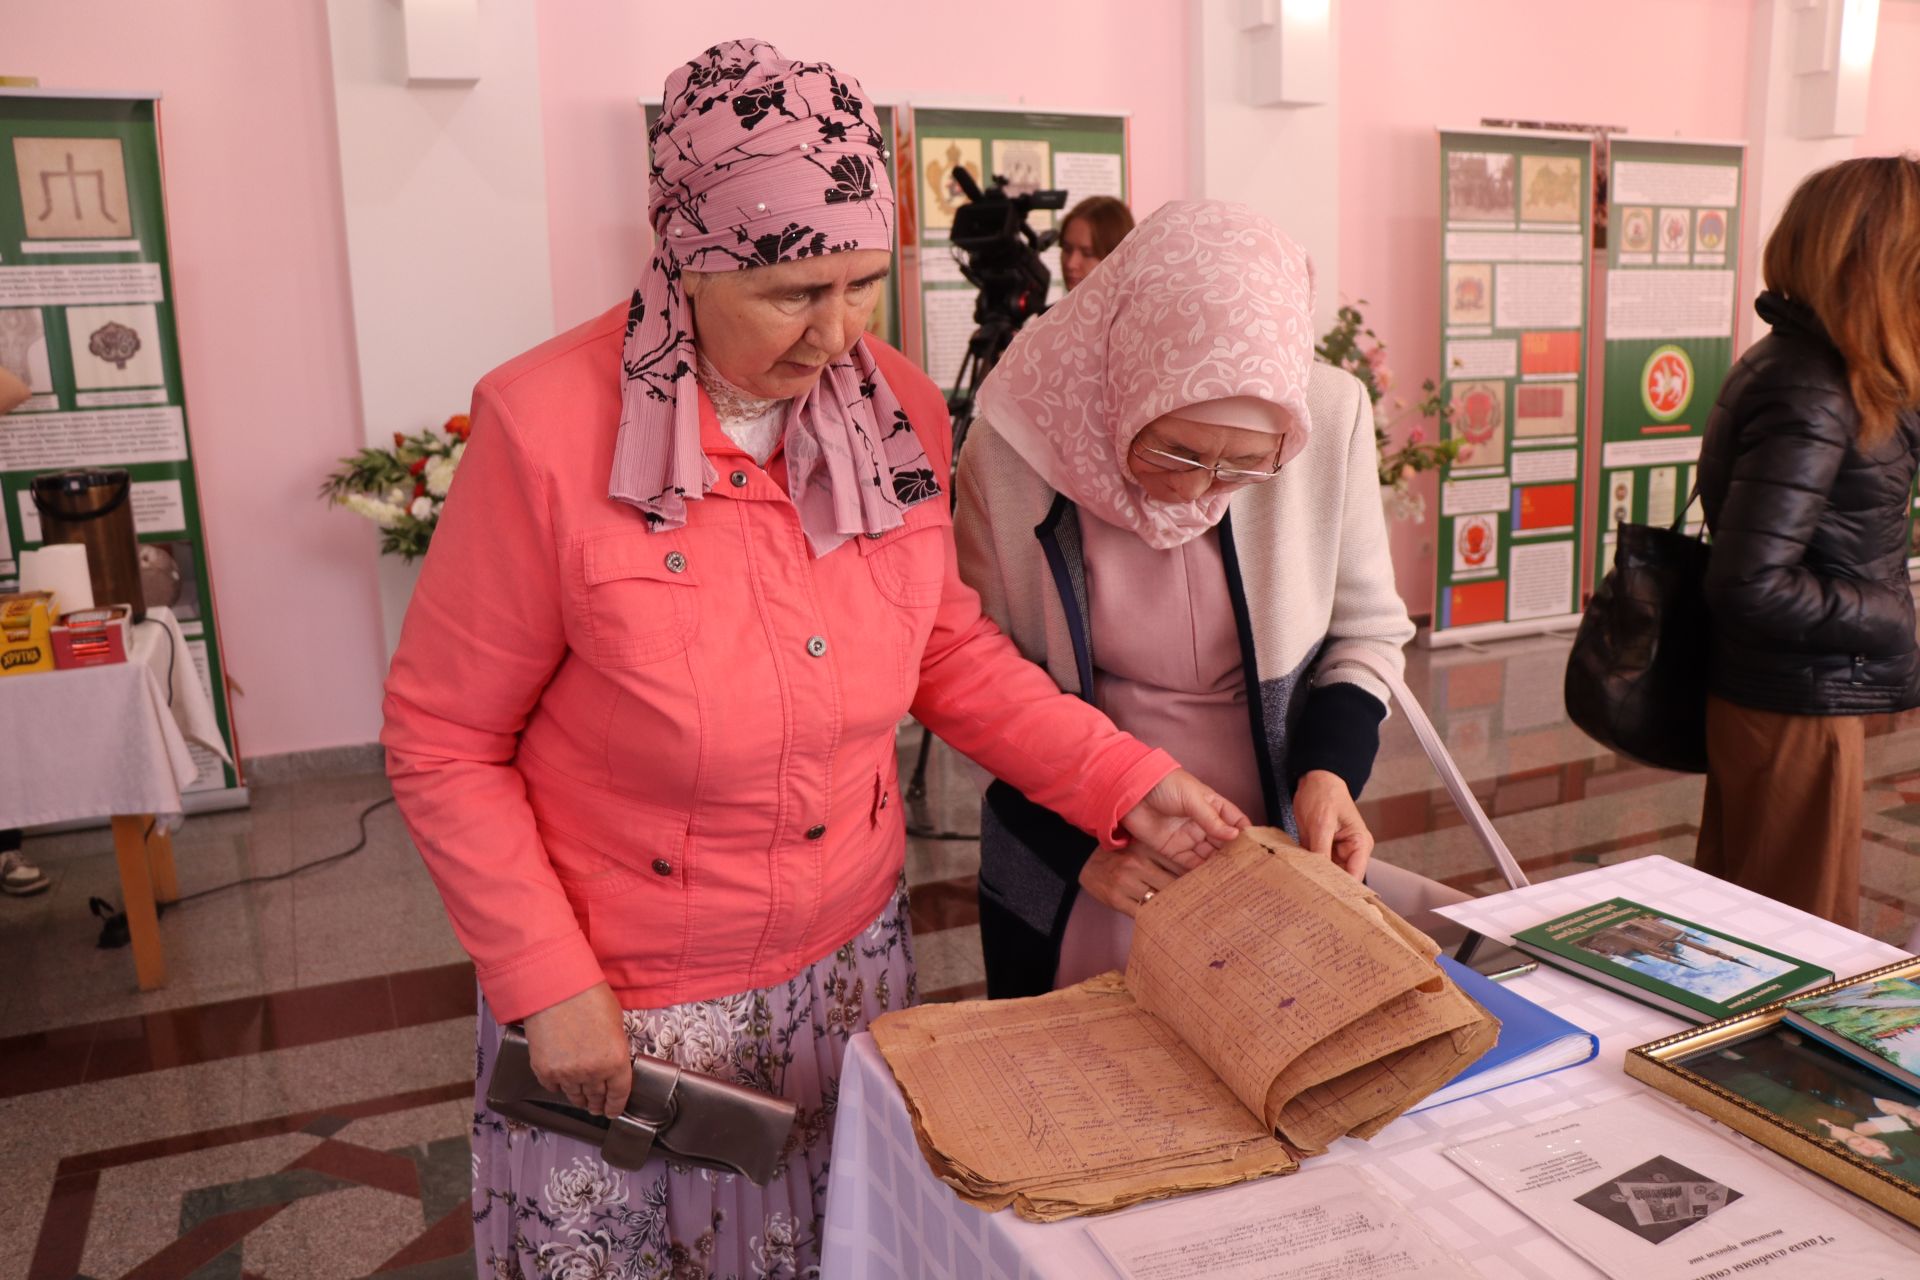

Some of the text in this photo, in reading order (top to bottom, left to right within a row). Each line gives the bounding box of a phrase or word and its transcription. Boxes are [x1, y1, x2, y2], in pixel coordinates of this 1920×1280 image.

[4, 649, 38, 667] ХРУТКА
[1705, 1244, 1738, 1258] проект
[1732, 1247, 1787, 1272] альбомы
